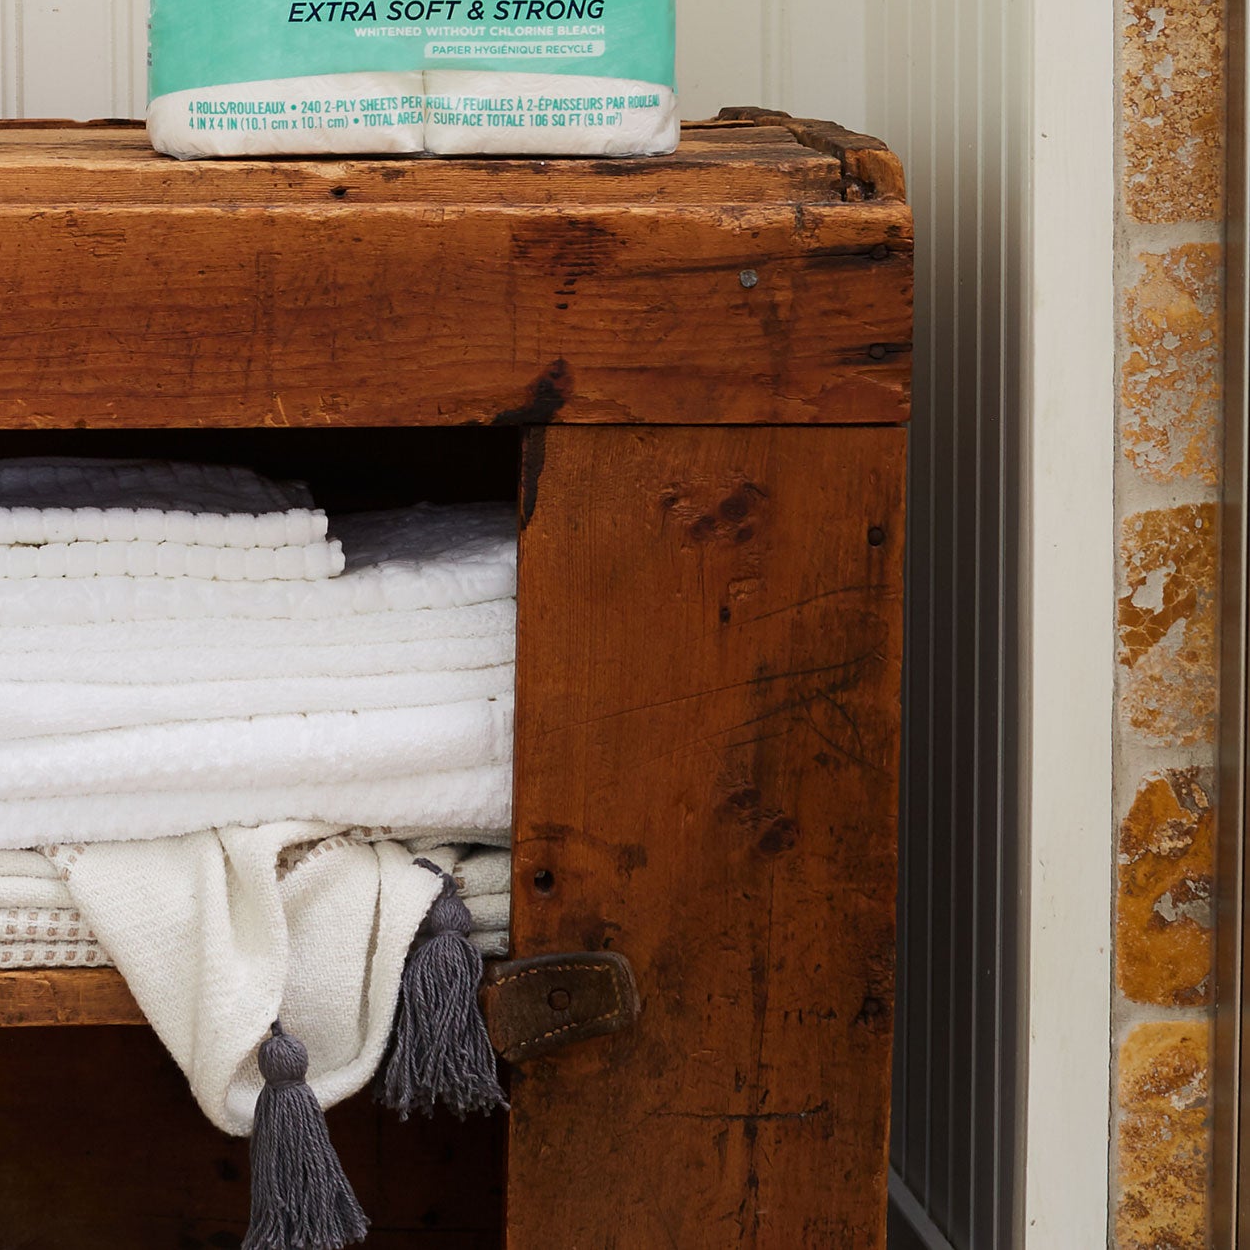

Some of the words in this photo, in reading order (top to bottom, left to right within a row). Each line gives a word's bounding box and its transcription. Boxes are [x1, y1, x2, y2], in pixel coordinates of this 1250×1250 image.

[288, 0, 377, 22] EXTRA
[386, 0, 461, 21] SOFT
[467, 0, 484, 20] &
[354, 26, 422, 37] WHITENED
[426, 26, 486, 36] WITHOUT
[489, 25, 554, 36] CHLORINE
[557, 25, 605, 35] BLEACH
[432, 45, 471, 54] PAPIER
[474, 43, 543, 54] HYGIÉNIQUE
[545, 42, 593, 54] RECYCLÉ
[189, 101, 194, 114] 4
[196, 101, 286, 114] ROLLS/ROULEAUX
[301, 100, 321, 114] 240
[324, 99, 356, 113] 2-PLY
[359, 97, 398, 111] SHEETS
[401, 96, 422, 109] PER
[426, 96, 453, 110] ROLL
[463, 97, 513, 111] FEUILLES
[527, 96, 603, 111] 2-ÉPAISSEURS
[606, 96, 625, 109] PAR
[189, 117, 194, 130] 4
[197, 117, 206, 130] IN
[209, 117, 214, 130] X
[217, 117, 223, 130] 4
[227, 117, 237, 130] IN
[241, 117, 267, 131] (10.1
[271, 120, 289, 129] cm
[301, 117, 323, 129] 10.1
[327, 115, 349, 129] cm)
[362, 113, 395, 126] TOTAL
[397, 111, 423, 125] AREA
[433, 112, 483, 126] SURFACE
[486, 113, 525, 127] TOTALE
[529, 113, 549, 127] 106
[551, 113, 566, 127] SQ
[568, 113, 581, 126] FT
